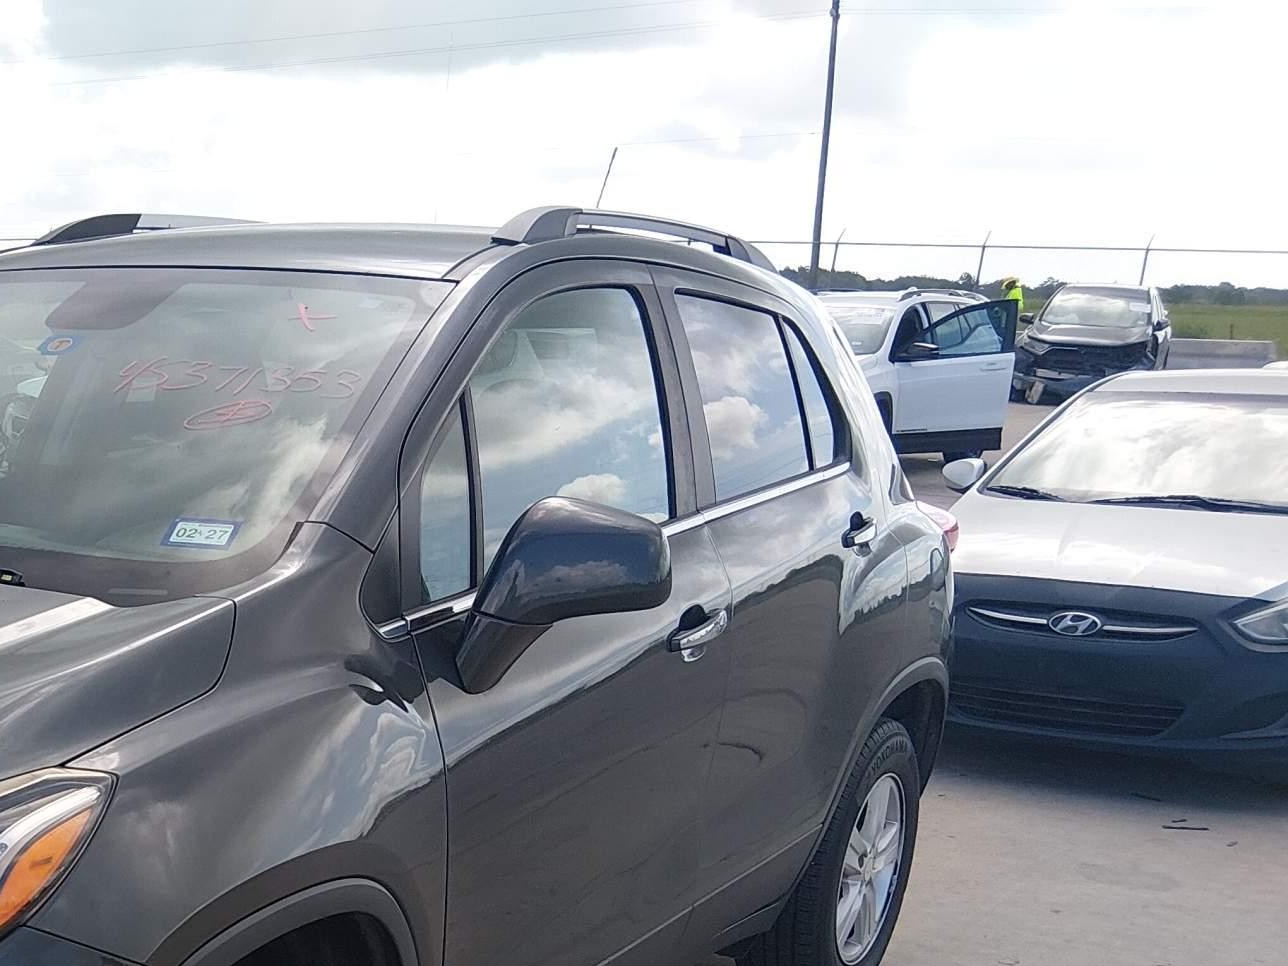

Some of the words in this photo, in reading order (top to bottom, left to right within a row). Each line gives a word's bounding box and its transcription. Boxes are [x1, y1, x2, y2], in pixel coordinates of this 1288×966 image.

[114, 355, 362, 398] 45371353
[175, 527, 198, 538] 02
[204, 529, 229, 540] 27
